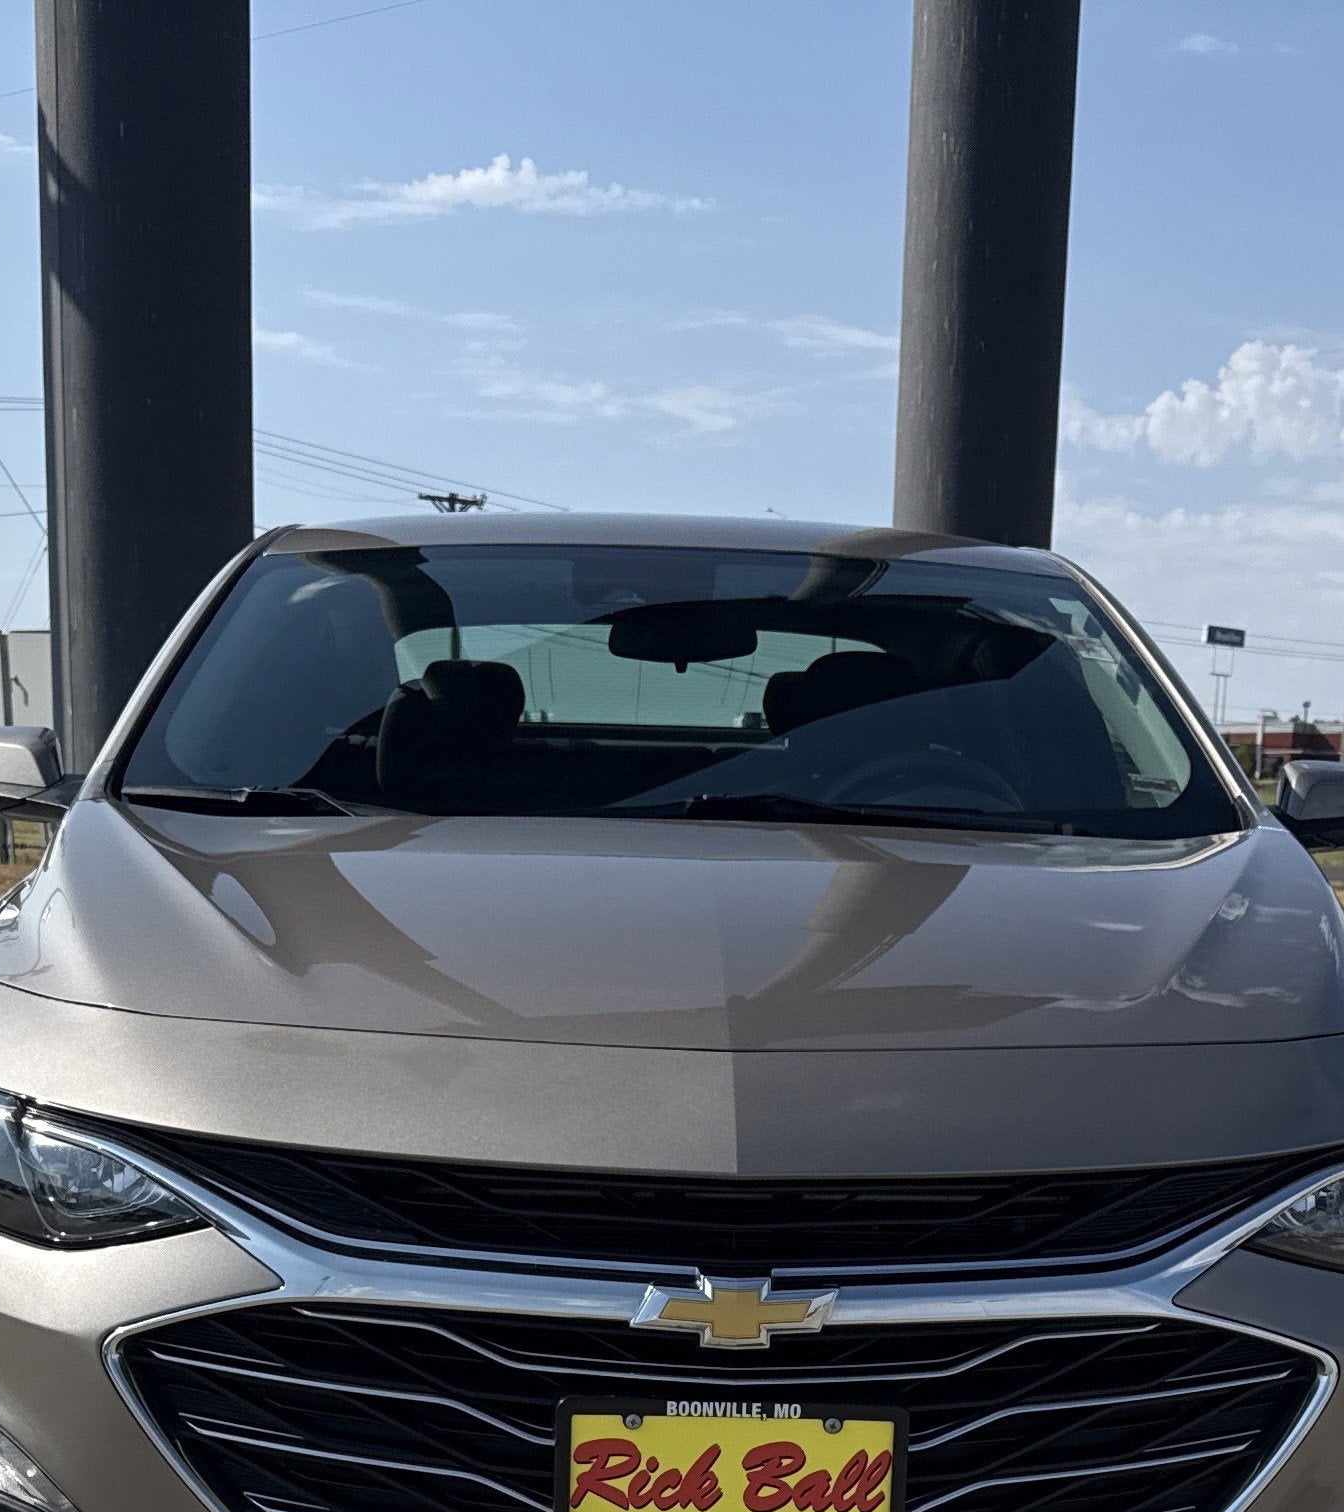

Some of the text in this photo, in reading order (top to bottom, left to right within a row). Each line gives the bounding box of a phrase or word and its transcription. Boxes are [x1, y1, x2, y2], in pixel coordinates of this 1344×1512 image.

[666, 1400, 802, 1421] BOONVILLE, MO
[570, 1437, 723, 1512] Rick
